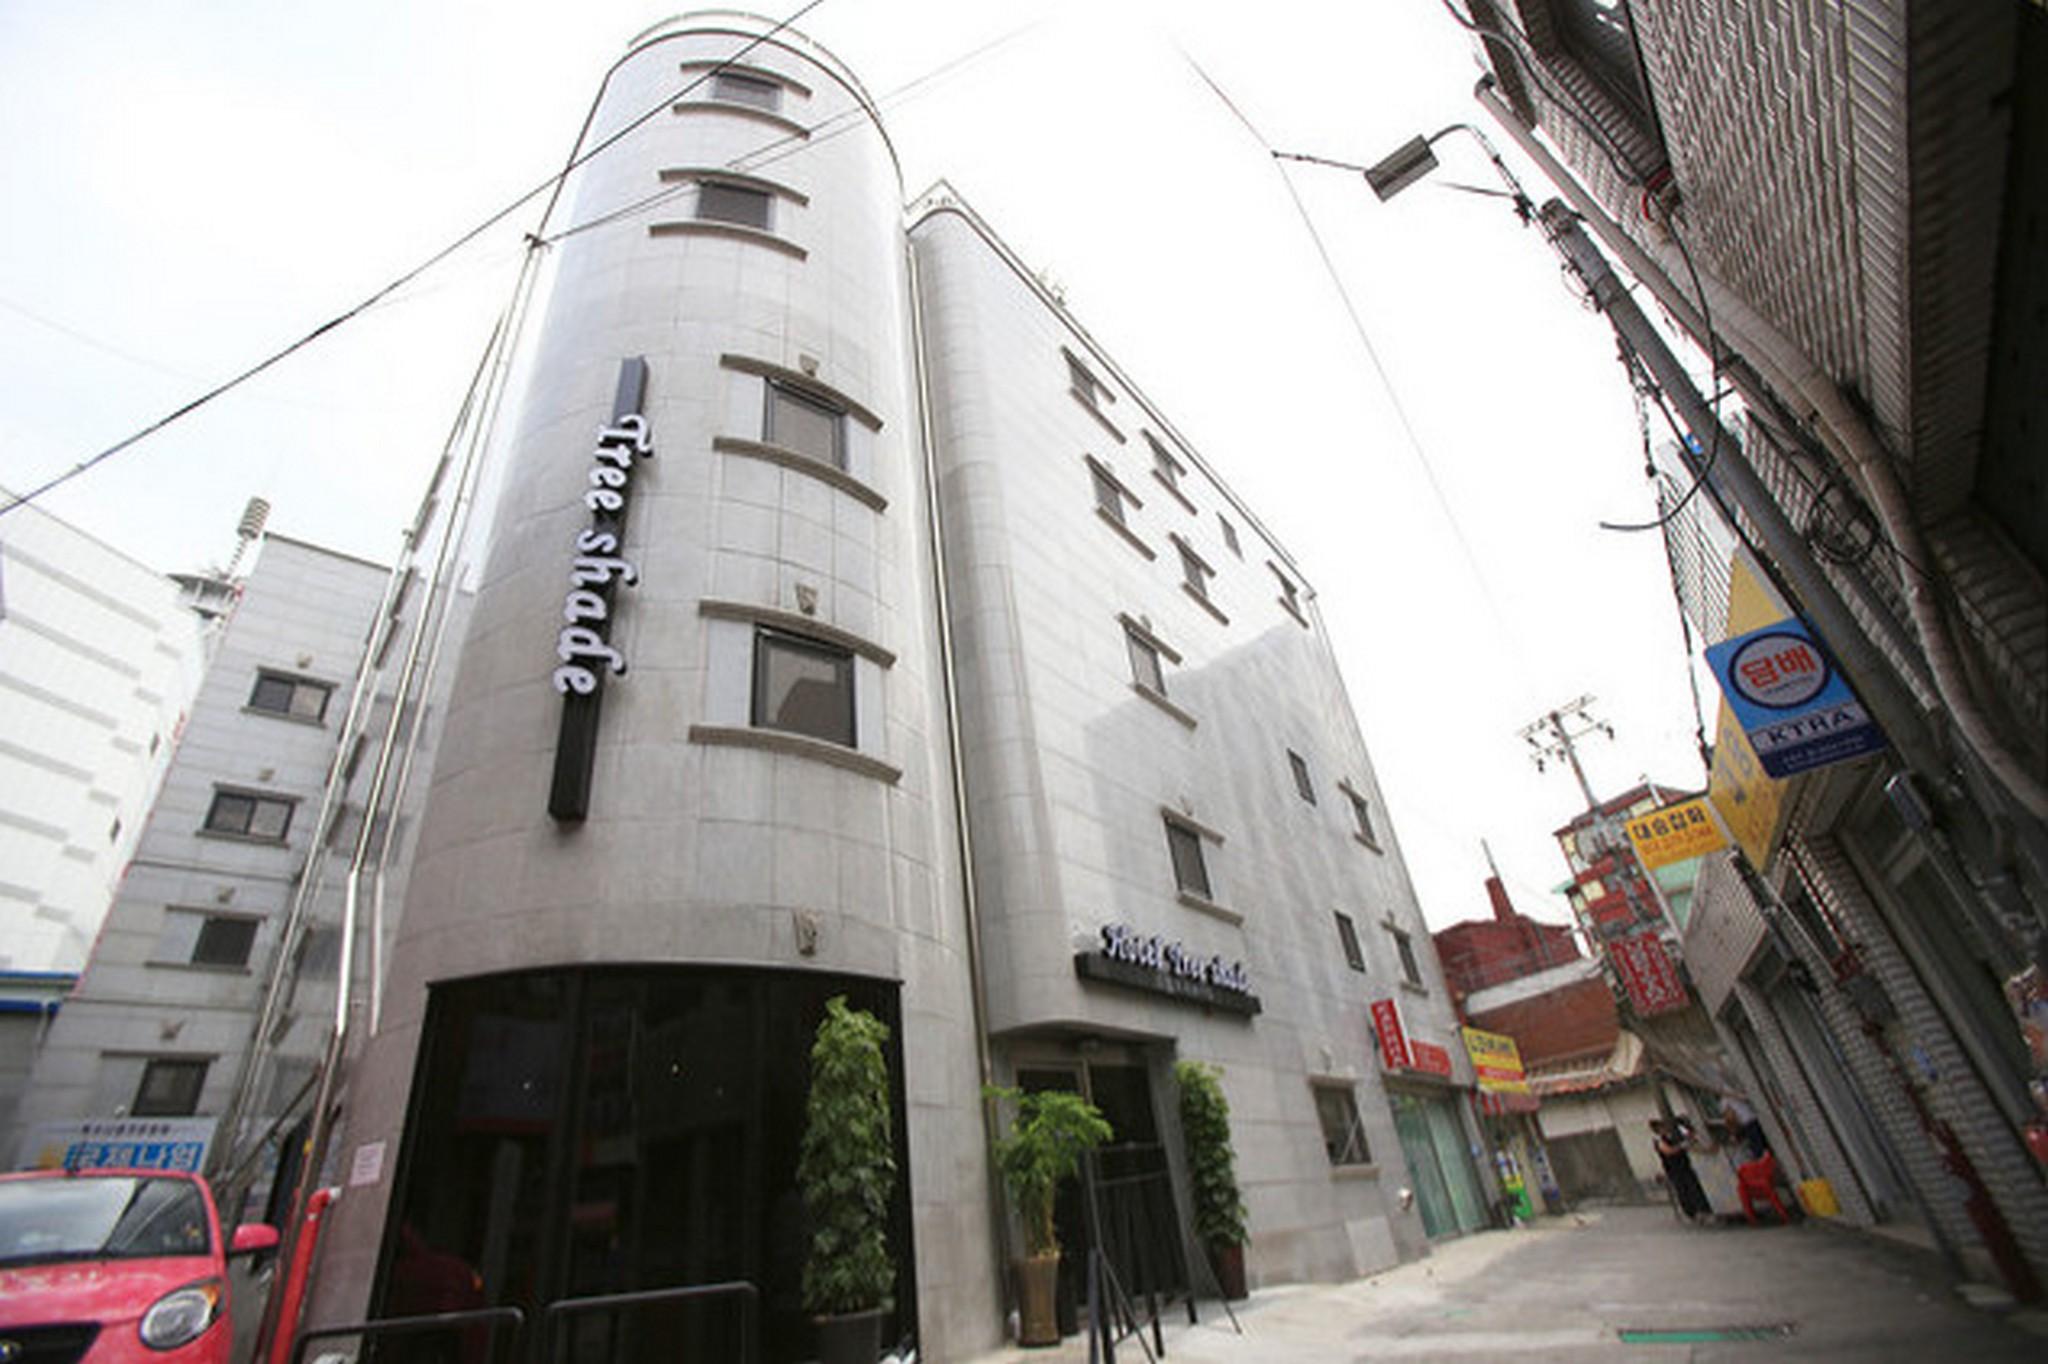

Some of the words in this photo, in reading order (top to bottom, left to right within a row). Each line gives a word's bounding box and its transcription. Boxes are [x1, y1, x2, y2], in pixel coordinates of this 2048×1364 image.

[586, 414, 649, 511] Tree
[553, 529, 634, 696] shade
[1741, 645, 1816, 688] 담배
